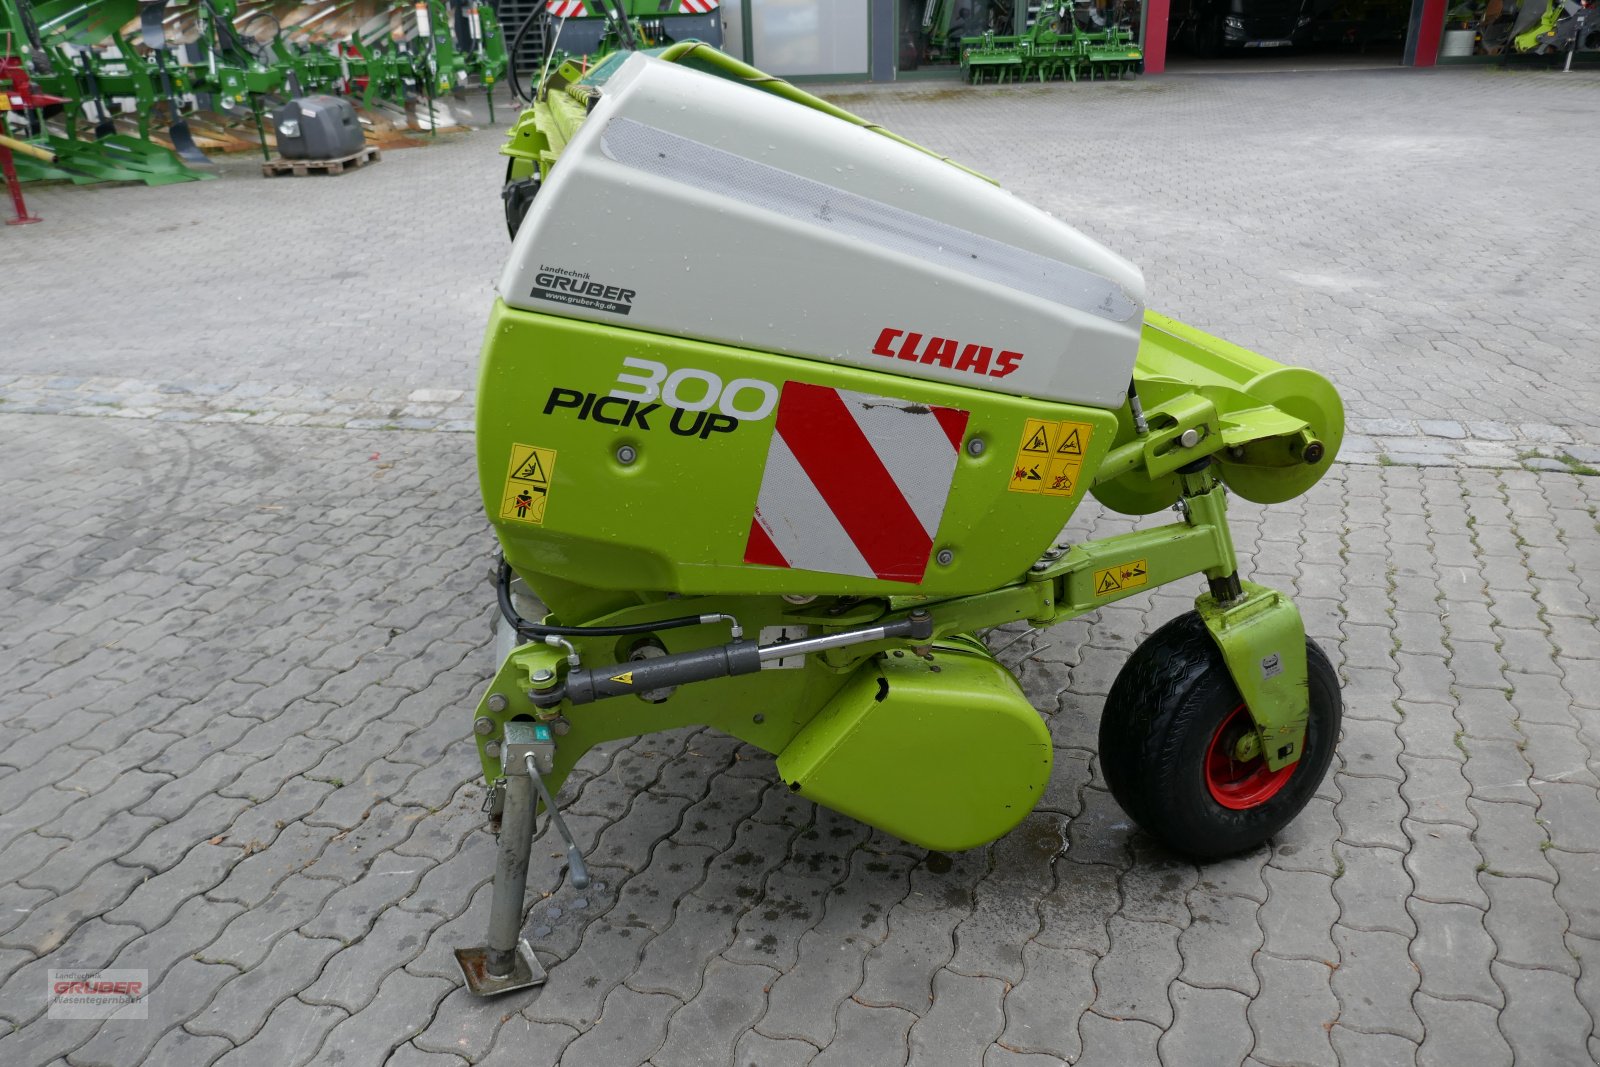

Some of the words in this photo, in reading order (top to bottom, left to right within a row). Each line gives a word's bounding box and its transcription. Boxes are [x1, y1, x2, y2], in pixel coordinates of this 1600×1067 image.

[535, 273, 636, 303] GRUBER
[540, 264, 591, 280] Landtechnik
[545, 292, 616, 311] www.gruber-kg.de
[872, 327, 1024, 378] CLAAS
[609, 356, 778, 421] 300
[542, 387, 662, 430] PICK
[669, 407, 739, 440] UP
